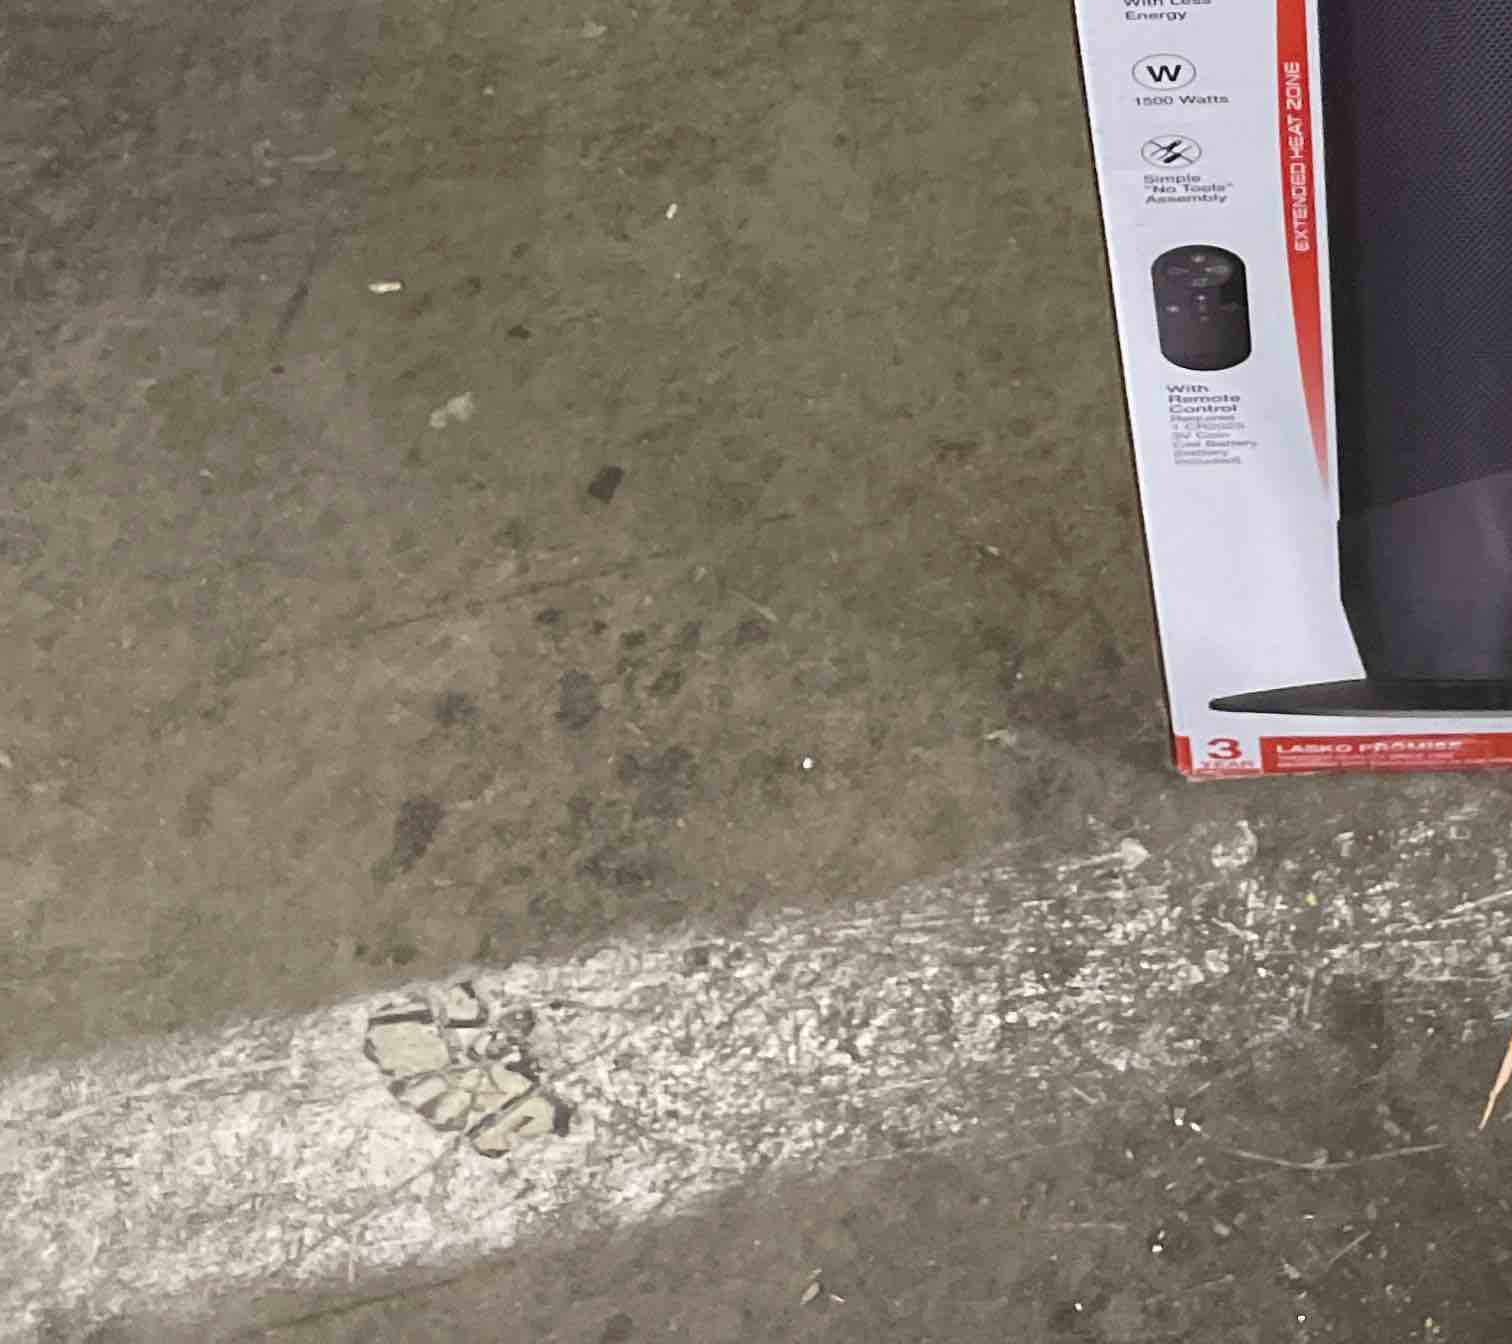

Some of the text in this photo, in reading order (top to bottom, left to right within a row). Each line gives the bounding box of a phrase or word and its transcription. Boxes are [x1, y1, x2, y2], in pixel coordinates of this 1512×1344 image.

[1126, 10, 1187, 21] Energy
[1136, 94, 1229, 106] 1500 Watts
[1284, 61, 1310, 251] EXTENDED HEAT ZONE
[1144, 174, 1201, 184] Simple
[1146, 194, 1228, 205] Assembly
[1166, 384, 1210, 394] With
[1168, 394, 1240, 403] Remote
[1169, 404, 1238, 414] Control
[1207, 738, 1242, 761] 3
[1276, 743, 1353, 754] LASKO
